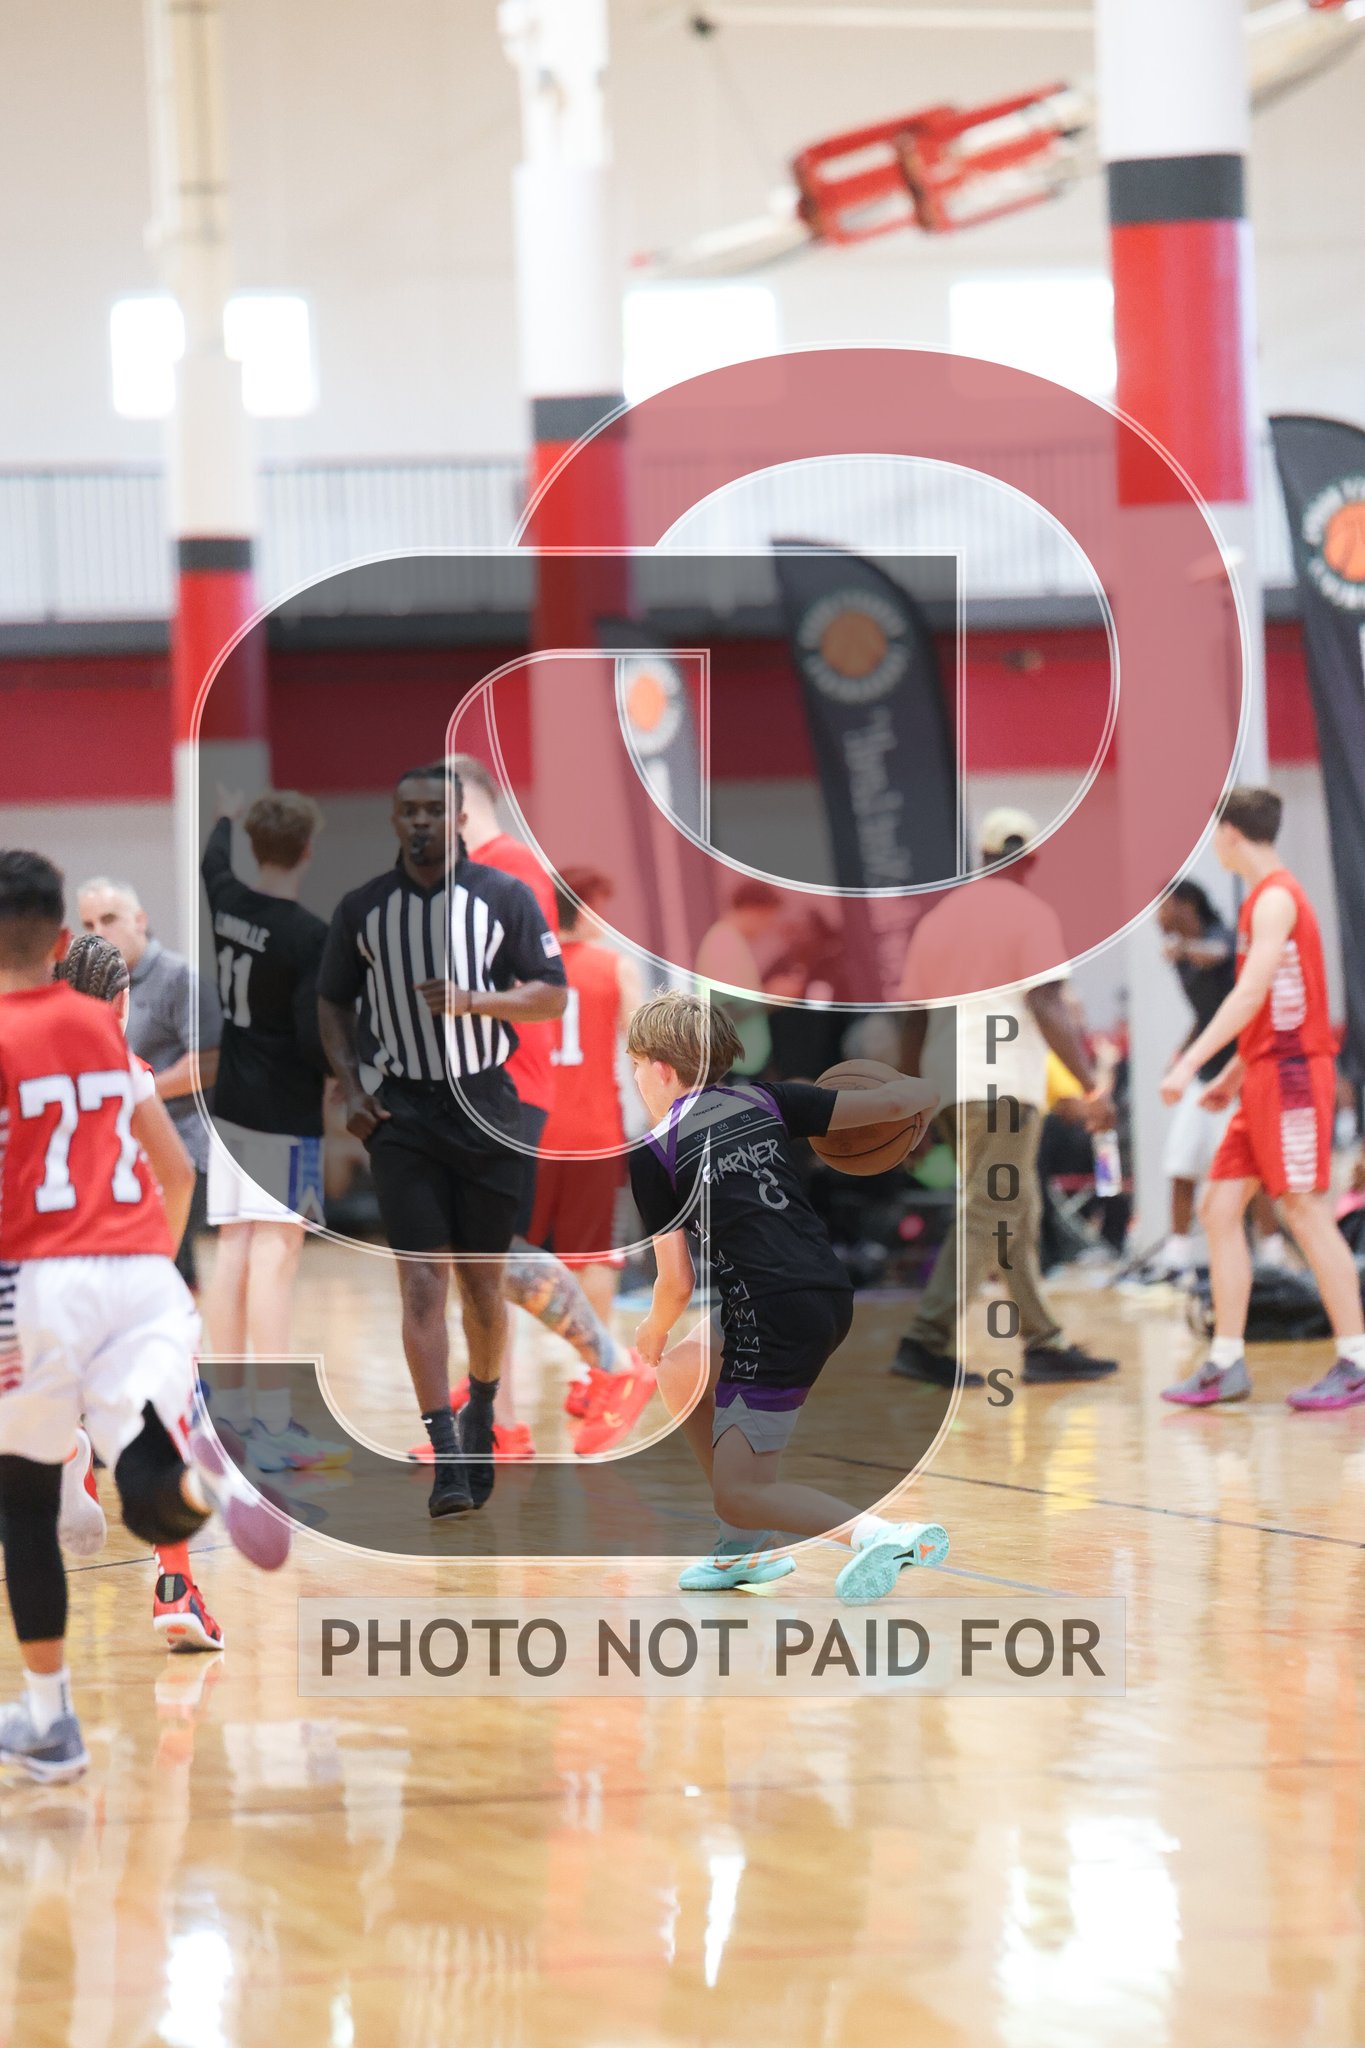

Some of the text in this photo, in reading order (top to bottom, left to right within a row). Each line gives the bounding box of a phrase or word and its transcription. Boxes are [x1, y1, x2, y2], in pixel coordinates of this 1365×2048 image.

[218, 945, 253, 1028] 11
[19, 1070, 142, 1213] 77
[701, 1138, 787, 1186] GARNER
